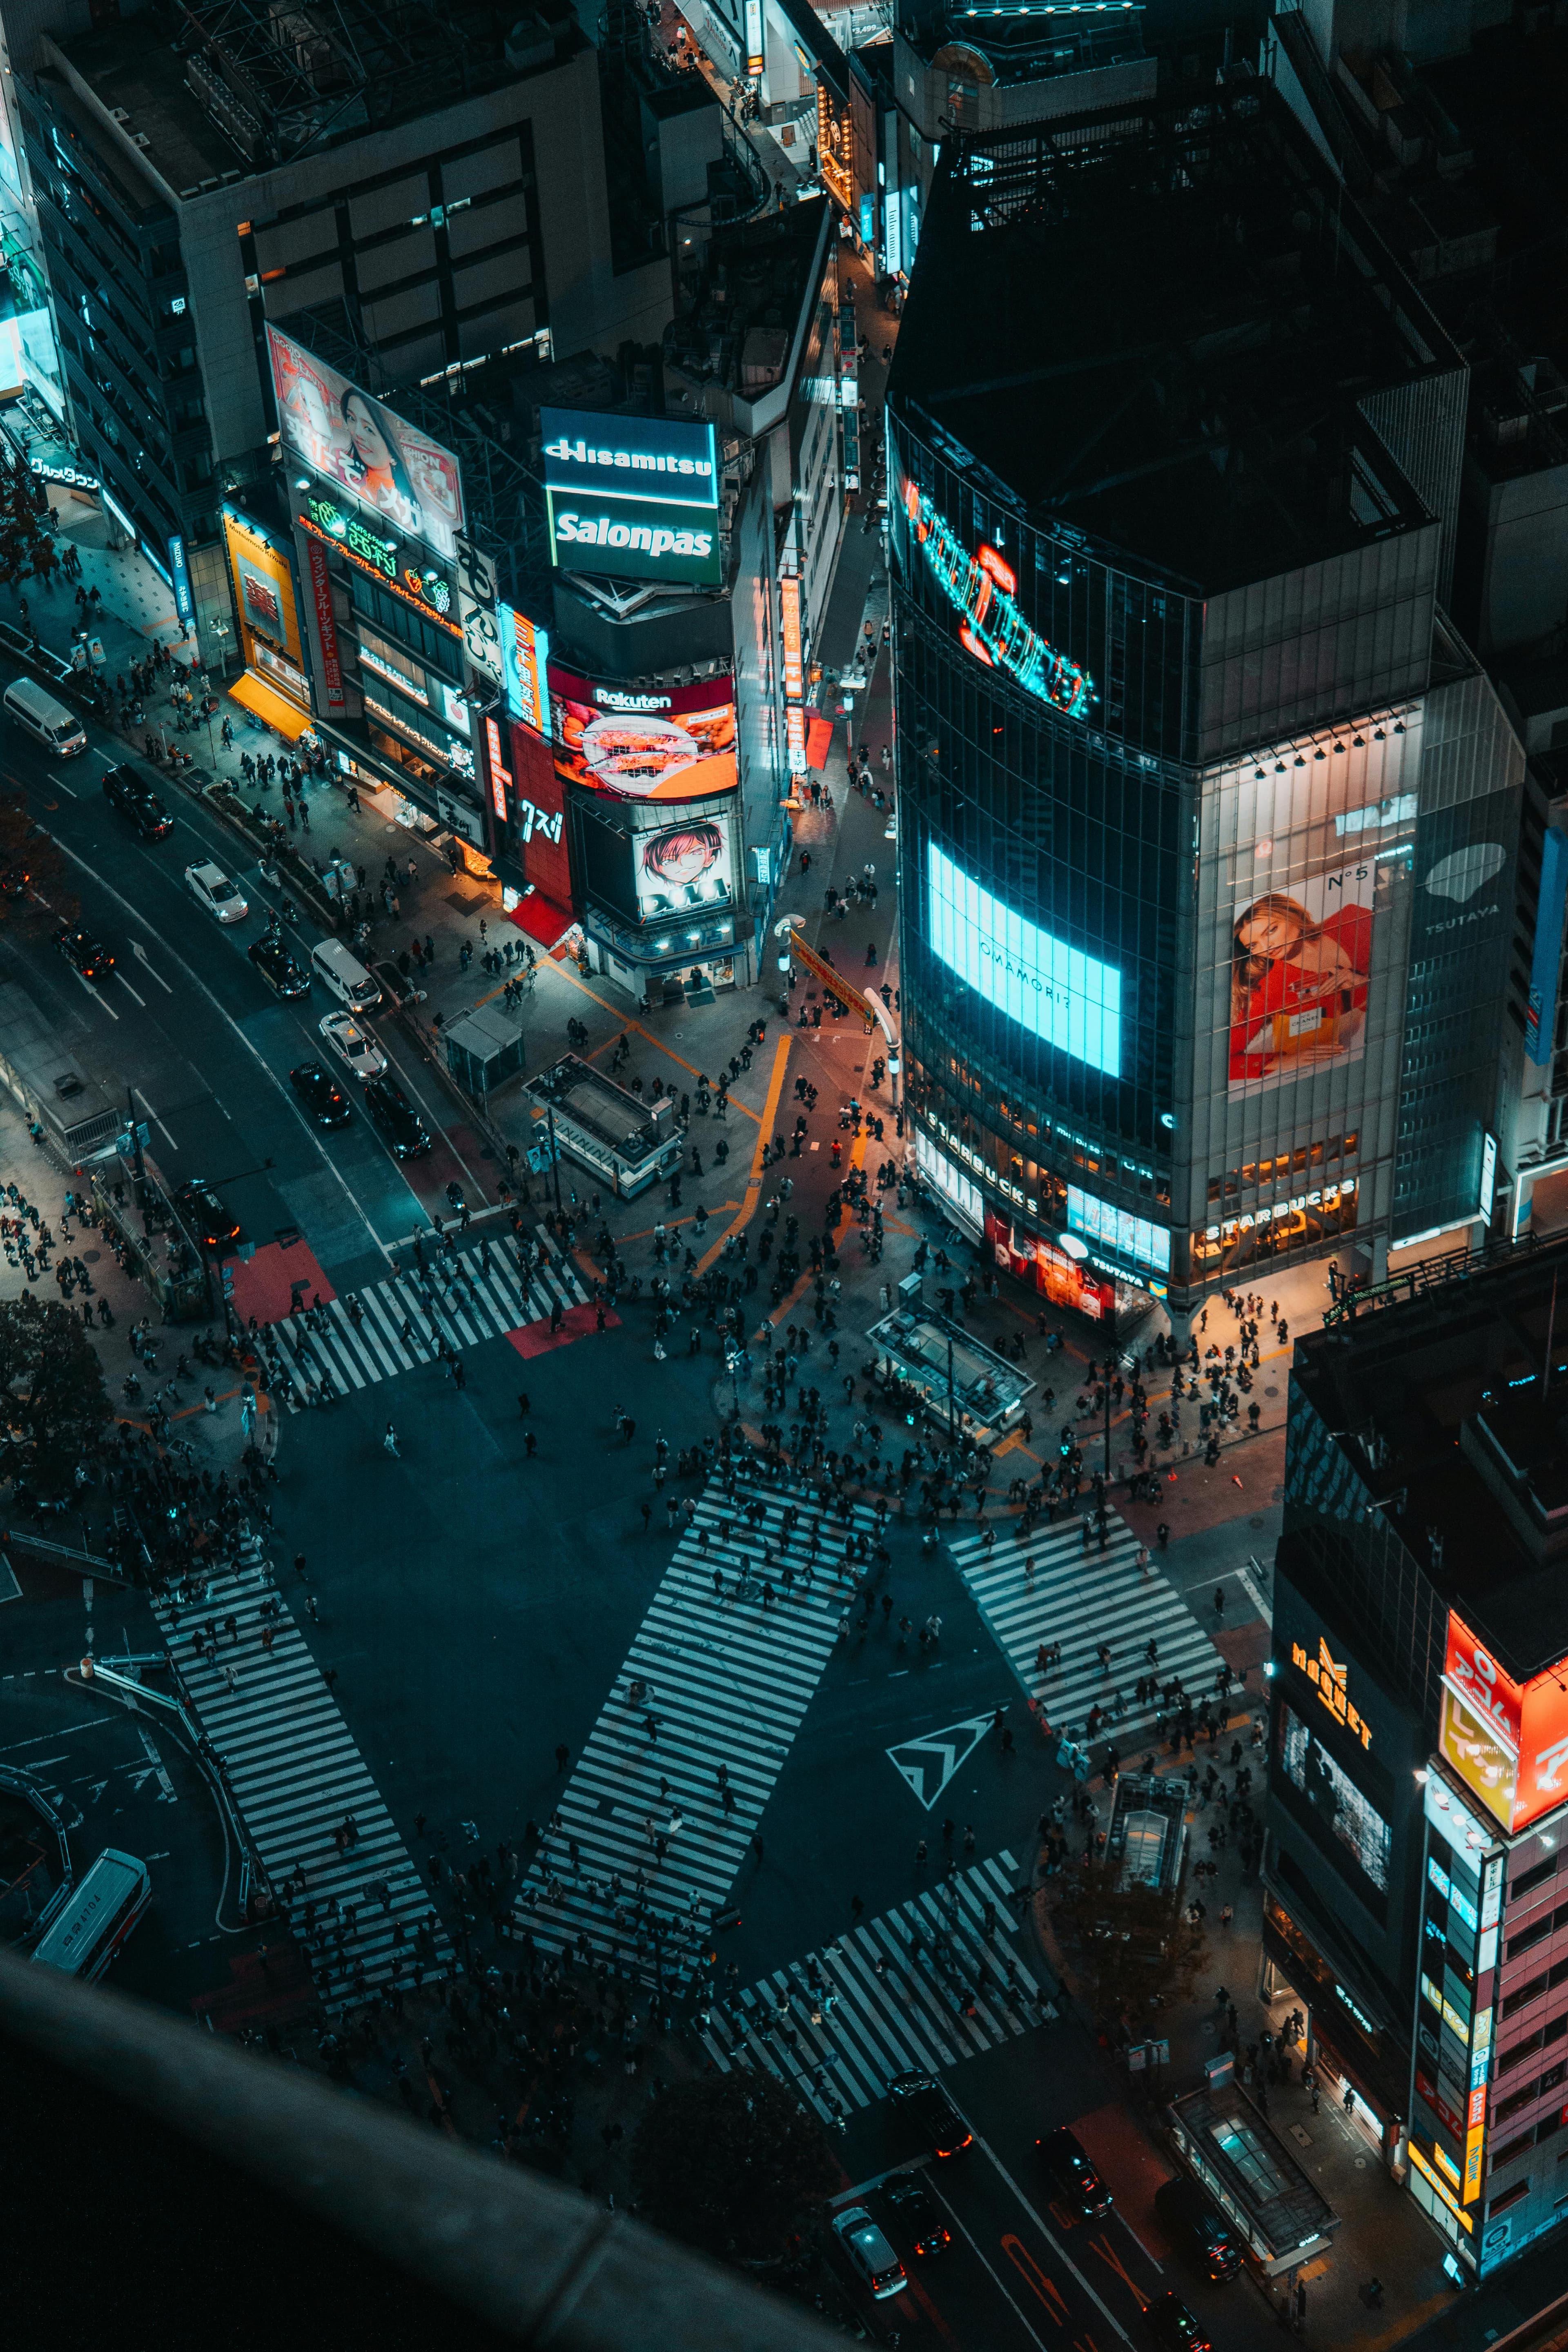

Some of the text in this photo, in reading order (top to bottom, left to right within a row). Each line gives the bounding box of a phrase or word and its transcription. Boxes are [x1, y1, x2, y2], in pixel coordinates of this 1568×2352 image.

[31, 457, 98, 489] グルメタウン
[403, 446, 440, 470] ASHION
[546, 439, 712, 476] Hisamitsu
[229, 523, 264, 552] Matsumoto
[556, 514, 712, 557] Salonpas
[173, 541, 183, 568] MIZUHO
[179, 586, 189, 613] みずほ銀行
[313, 555, 334, 651] ウィンターフルーツギフト
[514, 621, 538, 727] 三千里薬品
[596, 688, 672, 709] Rakuten
[1425, 904, 1500, 935] TSUTAYA
[928, 1111, 1038, 1213] STARBUCKS
[1205, 1179, 1355, 1241] STARBUCKS
[1091, 1256, 1144, 1287] TSUTAYA
[80, 1895, 101, 1923] 4704
[1430, 1985, 1468, 2034] レイク
[1469, 2144, 1481, 2184] プロミス
[1421, 2159, 1460, 2212] プロミス
